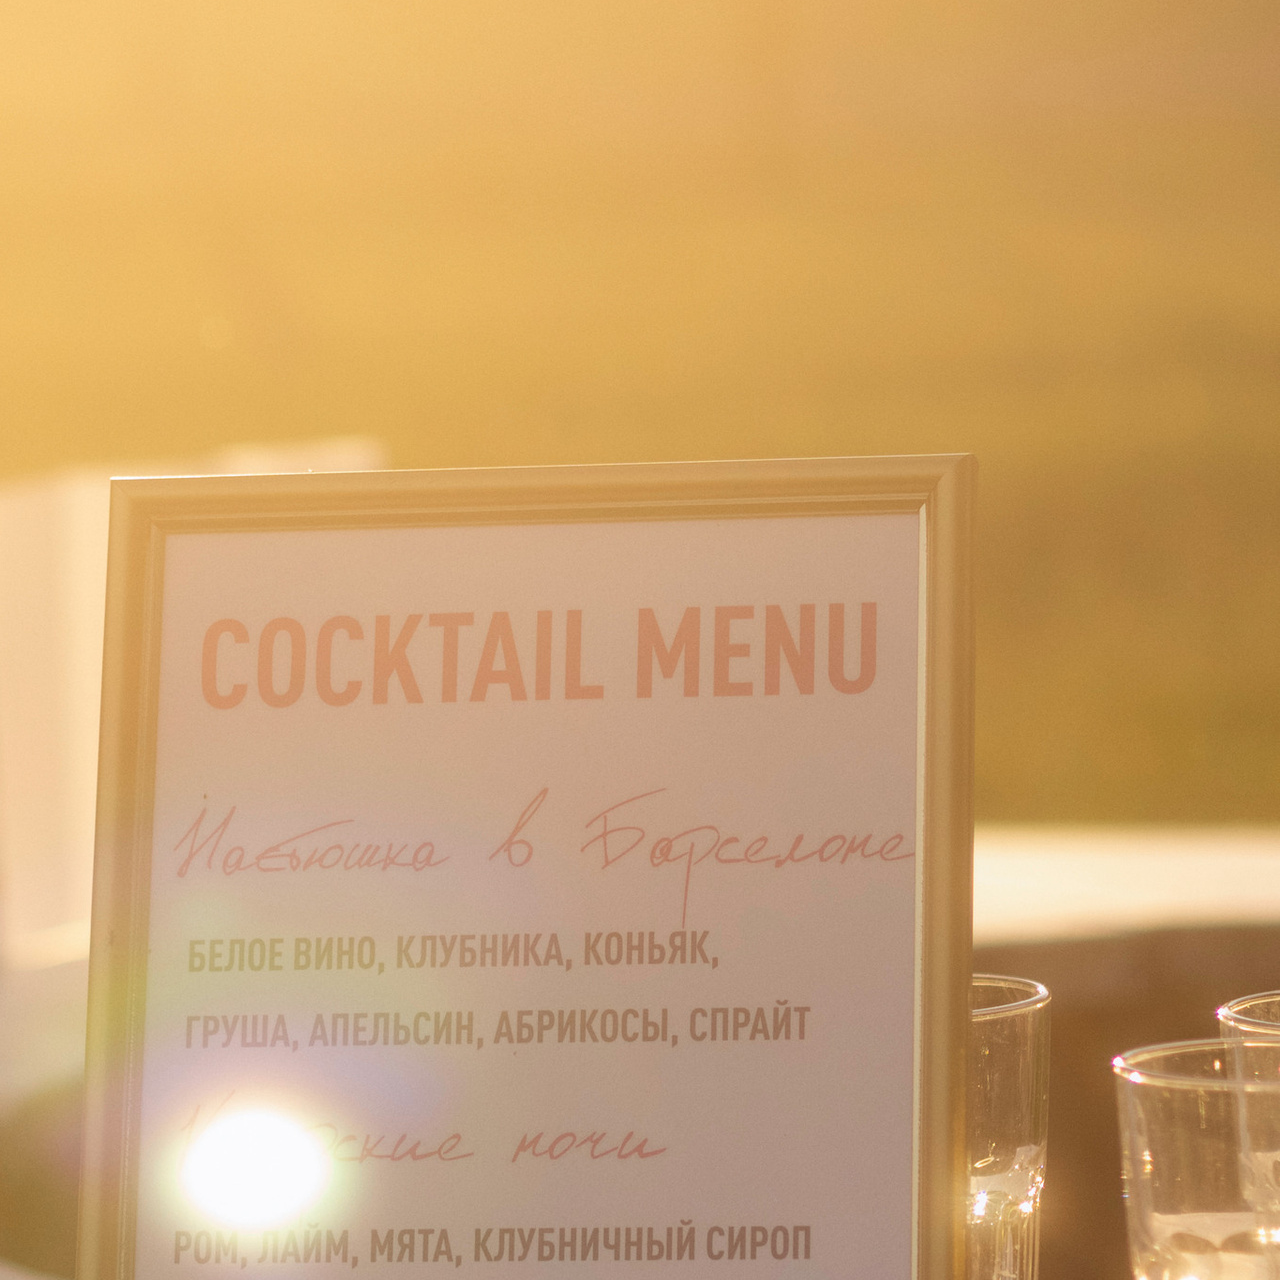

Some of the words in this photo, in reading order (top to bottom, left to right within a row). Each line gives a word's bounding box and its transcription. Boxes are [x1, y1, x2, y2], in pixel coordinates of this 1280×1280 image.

[202, 610, 604, 710] COCKTAIL
[636, 602, 877, 698] MENU
[489, 787, 549, 867] в
[580, 788, 914, 929] Барселоне
[189, 938, 284, 972] БЕЛОЕ
[294, 936, 384, 974] ВИНО,
[397, 933, 572, 971] КЛУБНИКА,
[584, 930, 719, 968] КОНЬЯК,
[186, 1014, 299, 1052] ГРУША,
[309, 1011, 484, 1049] АПЕЛЬСИН,
[494, 1008, 678, 1047] АБРИКОСЫ,
[690, 1000, 811, 1042] СПРАЙТ
[510, 1127, 667, 1163] ночи
[173, 1232, 247, 1270] РОМ,
[258, 1229, 359, 1270] ЛАЙМ,
[369, 1228, 462, 1267] МЯТА,
[474, 1220, 695, 1262] КЛУБНИЧНЫЙ
[706, 1225, 811, 1260] СИРОП
